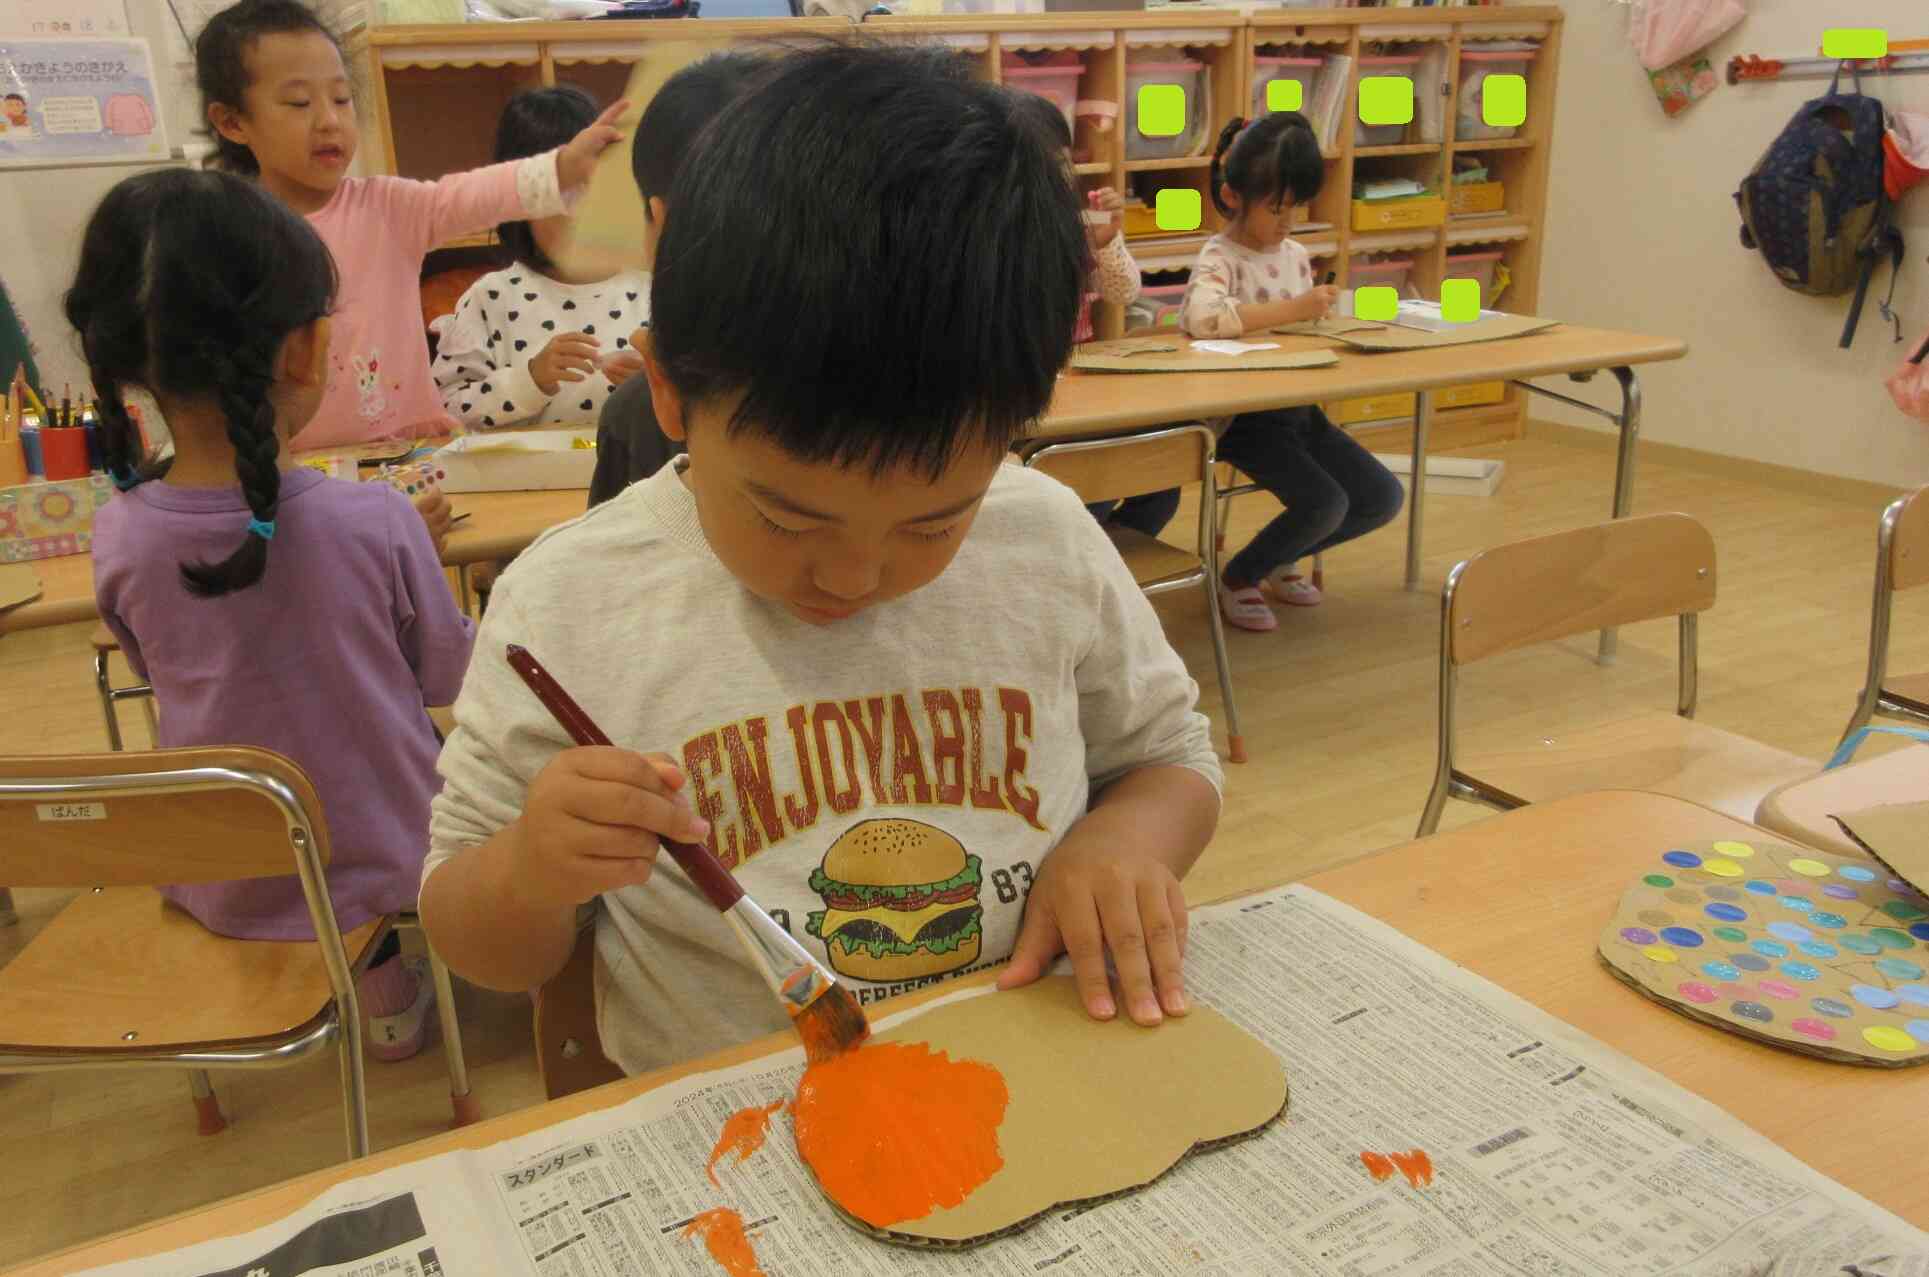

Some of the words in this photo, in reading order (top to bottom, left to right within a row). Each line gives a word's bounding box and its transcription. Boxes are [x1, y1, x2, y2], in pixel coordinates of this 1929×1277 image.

[683, 687, 1049, 871] ENJOYABLE
[991, 861, 1033, 904] 83
[507, 1144, 595, 1188] スタンダード
